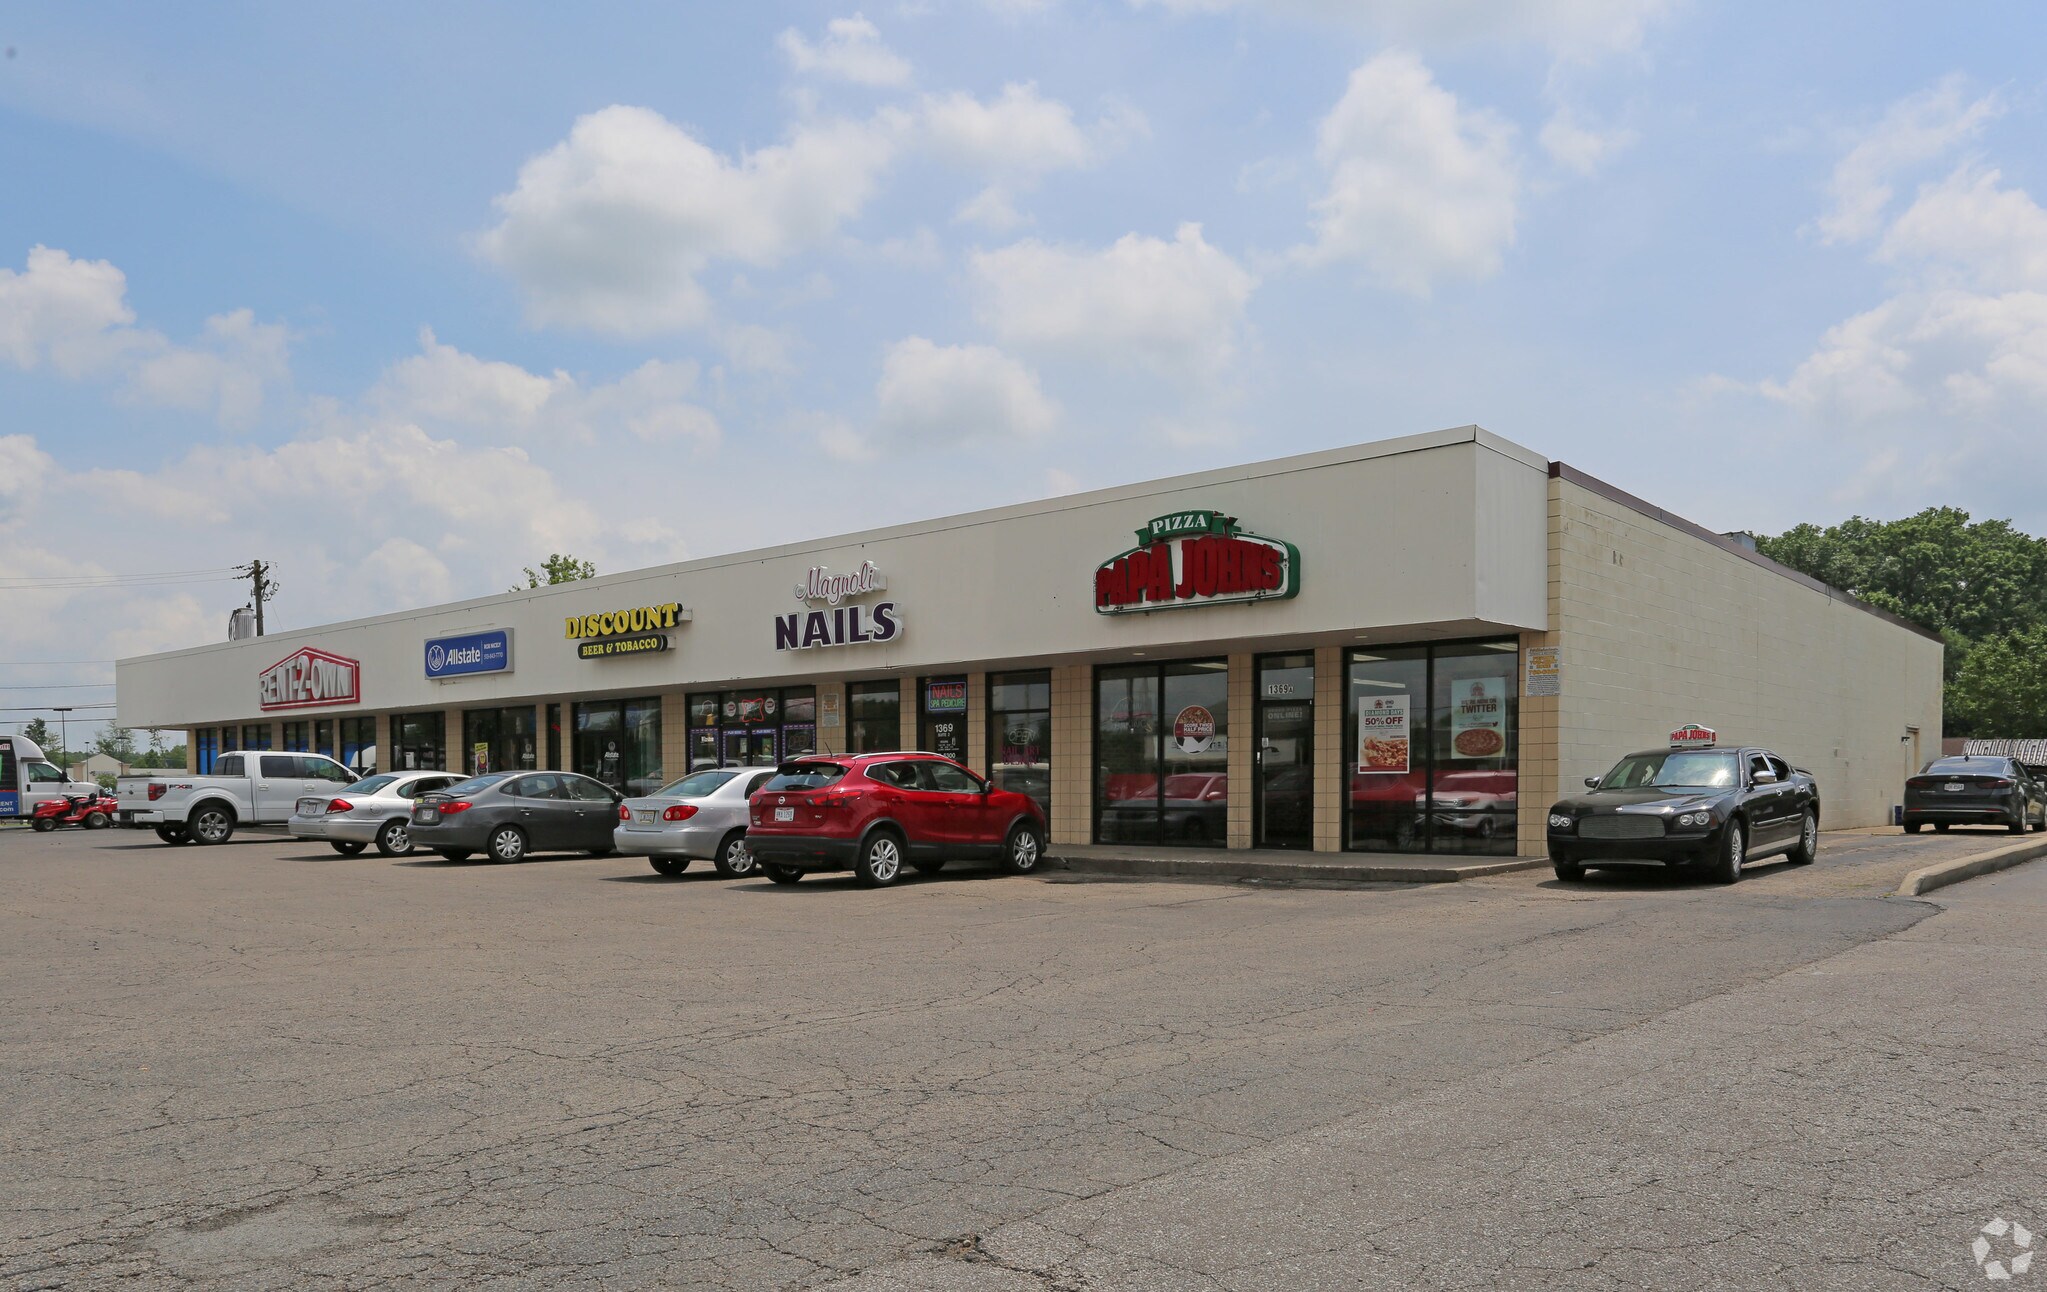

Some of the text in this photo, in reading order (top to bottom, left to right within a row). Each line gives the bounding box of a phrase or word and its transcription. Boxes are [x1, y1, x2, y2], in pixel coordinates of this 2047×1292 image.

[1152, 515, 1207, 535] PIZZA
[793, 560, 874, 605] Magnoli
[1096, 543, 1176, 607] PAPA
[565, 602, 679, 639] DISCOUNT
[775, 601, 897, 651] NAILS
[582, 637, 658, 656] BEER & TOBACCO
[445, 647, 481, 666] Allstate
[260, 655, 352, 703] RENT-2-OWN
[932, 684, 964, 698] NAILS
[930, 698, 966, 708] SPA PEDICURE
[1461, 703, 1497, 714] TWITTER
[935, 723, 954, 733] 1369
[1365, 716, 1404, 726] 50% OFF
[1009, 730, 1034, 742] OPEN
[1671, 730, 1688, 740] PAPA
